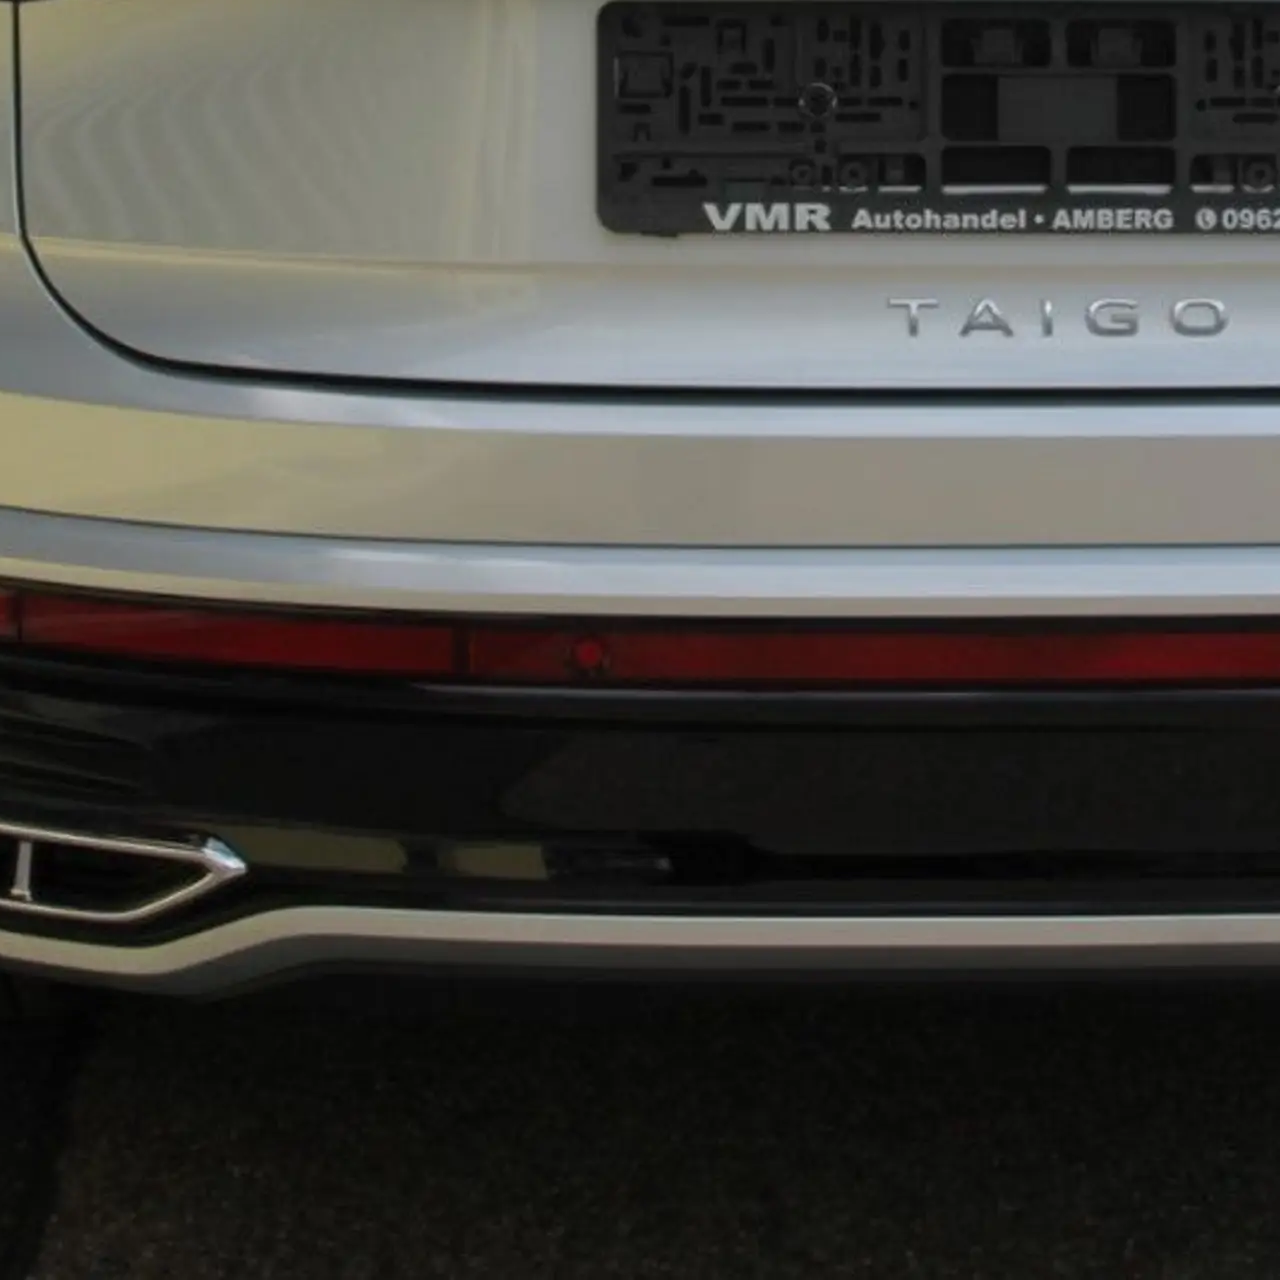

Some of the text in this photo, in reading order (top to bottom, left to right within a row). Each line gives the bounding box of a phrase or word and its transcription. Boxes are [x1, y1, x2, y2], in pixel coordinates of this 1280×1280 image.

[703, 202, 833, 231] VMR
[851, 208, 1027, 231] Autohandel
[1052, 208, 1175, 230] AMBERG
[886, 298, 1229, 338] TAIGO
